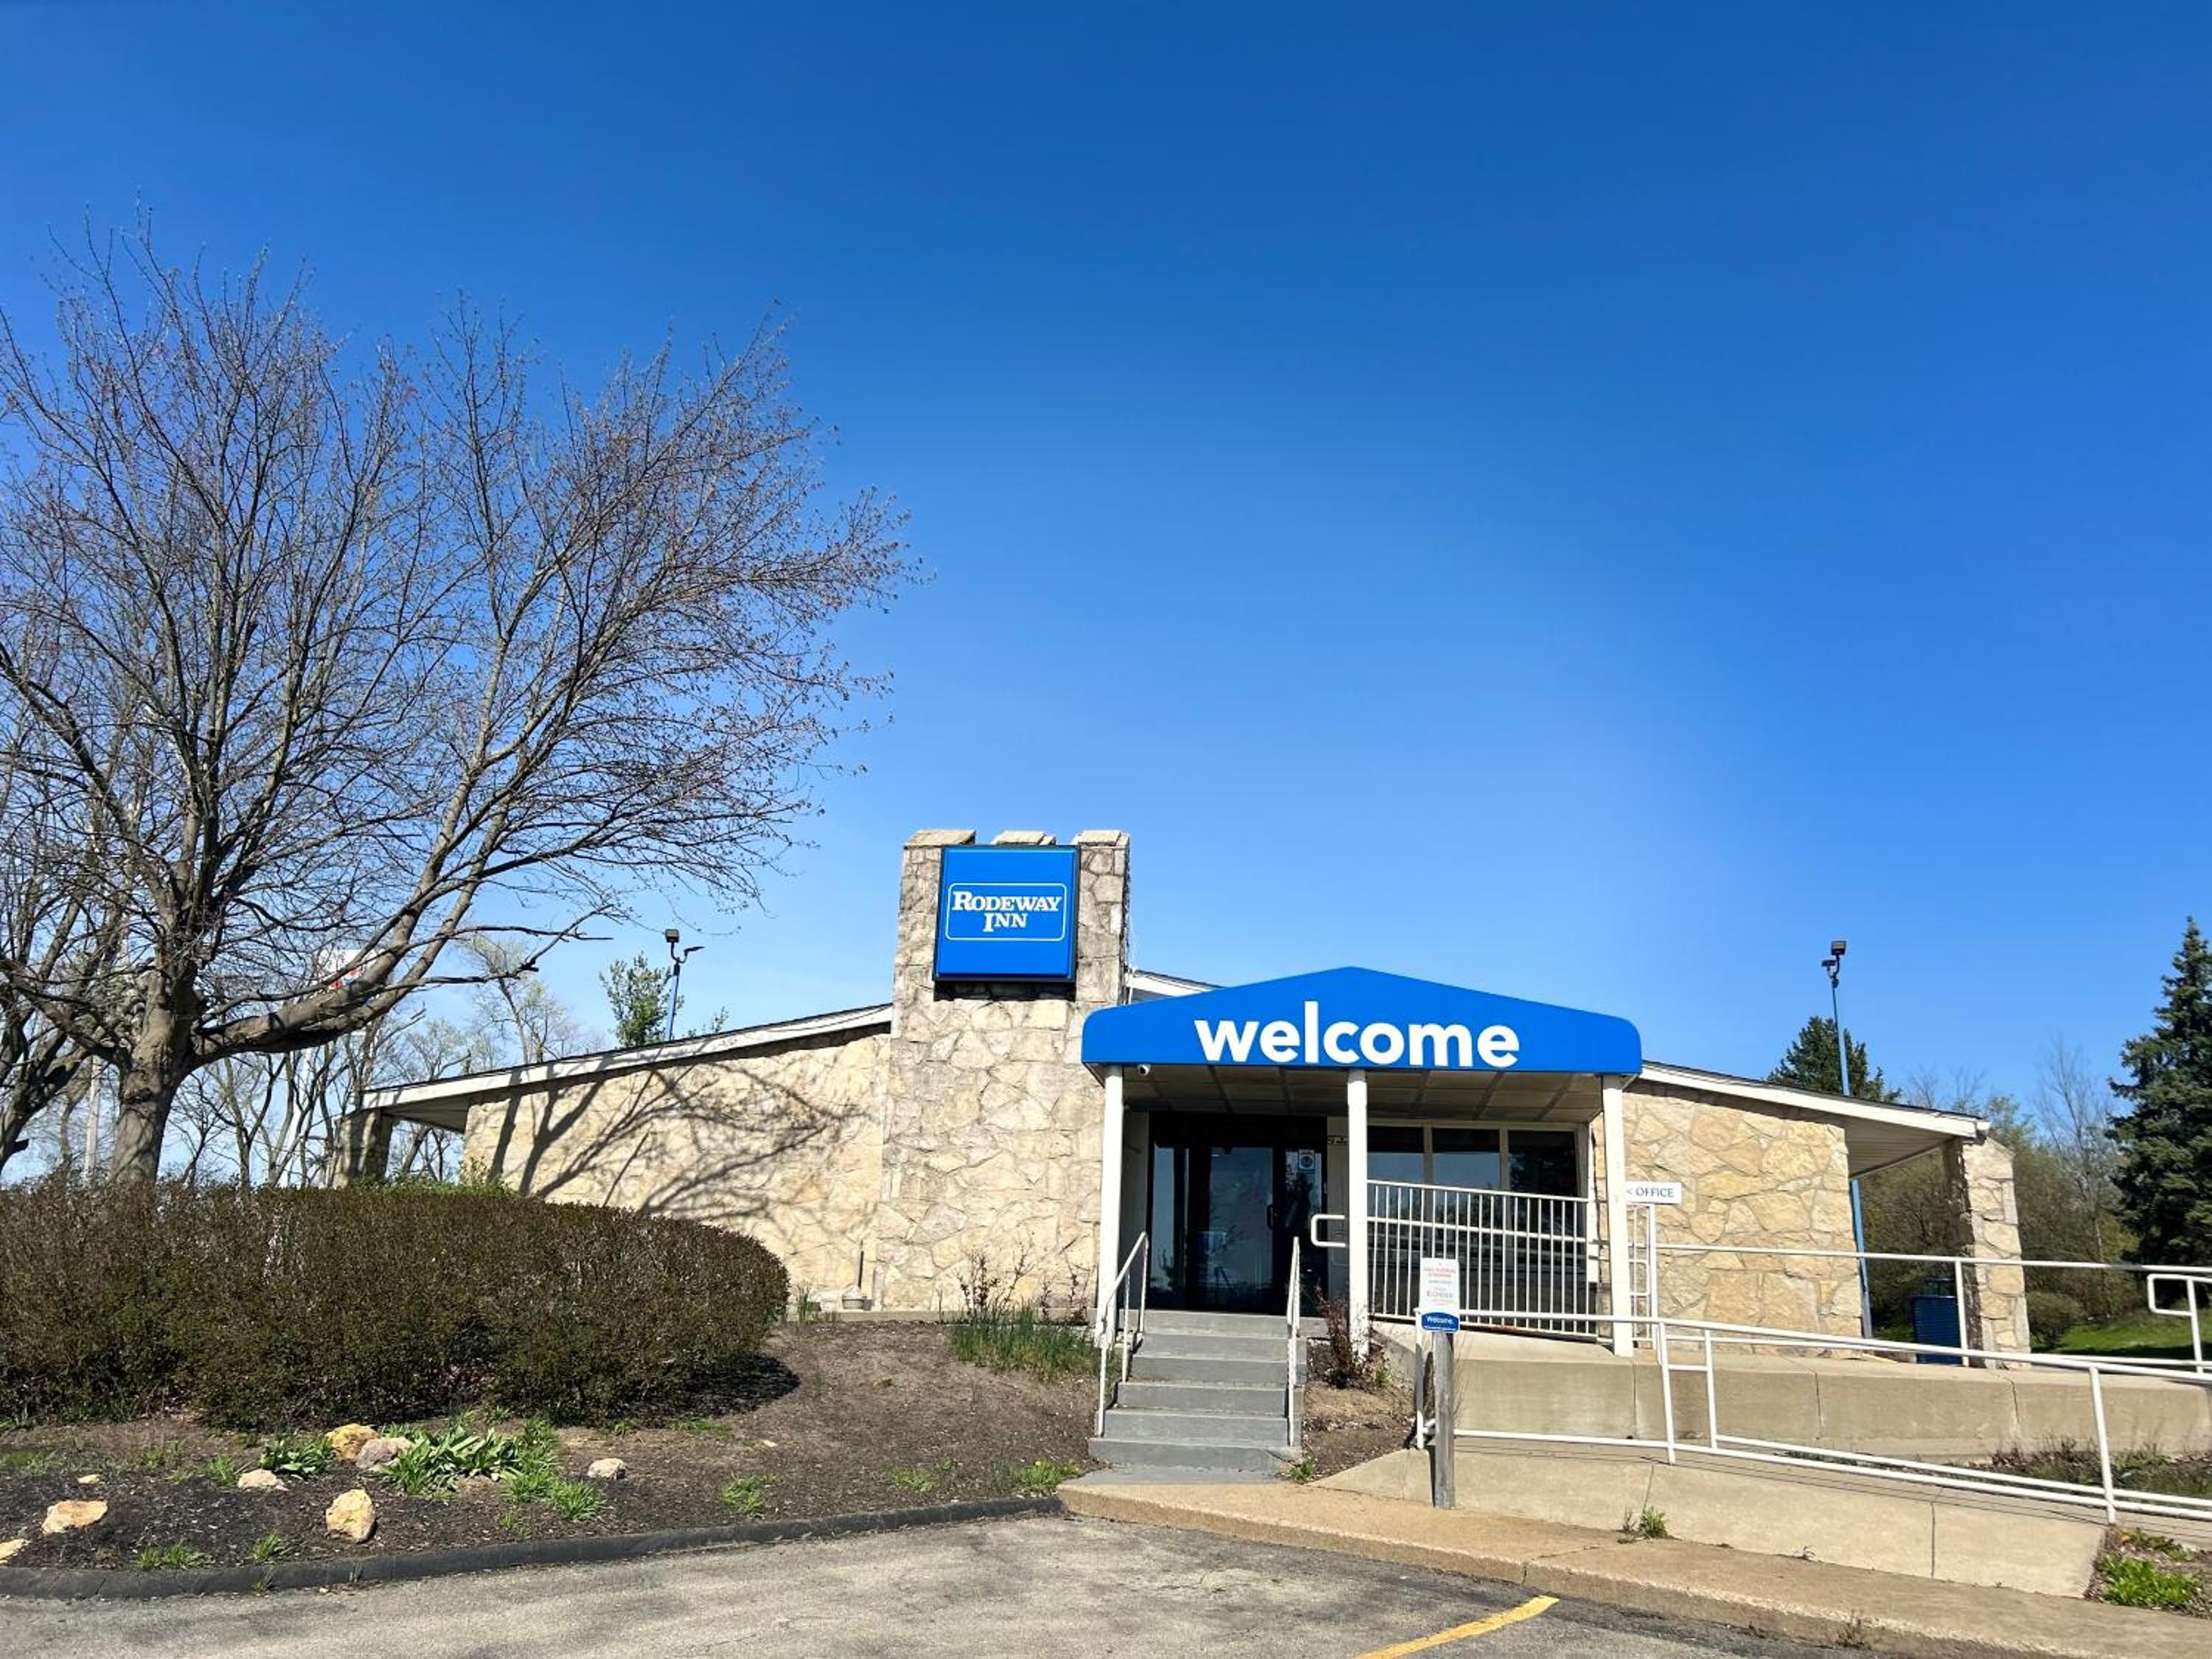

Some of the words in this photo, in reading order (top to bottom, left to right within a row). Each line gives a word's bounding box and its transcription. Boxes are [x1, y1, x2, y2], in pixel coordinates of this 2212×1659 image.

[952, 891, 1062, 911] RODEWAY
[982, 913, 1027, 932] INN
[1194, 1001, 1520, 1068] welcome
[1635, 1186, 1674, 1197] OFFICE
